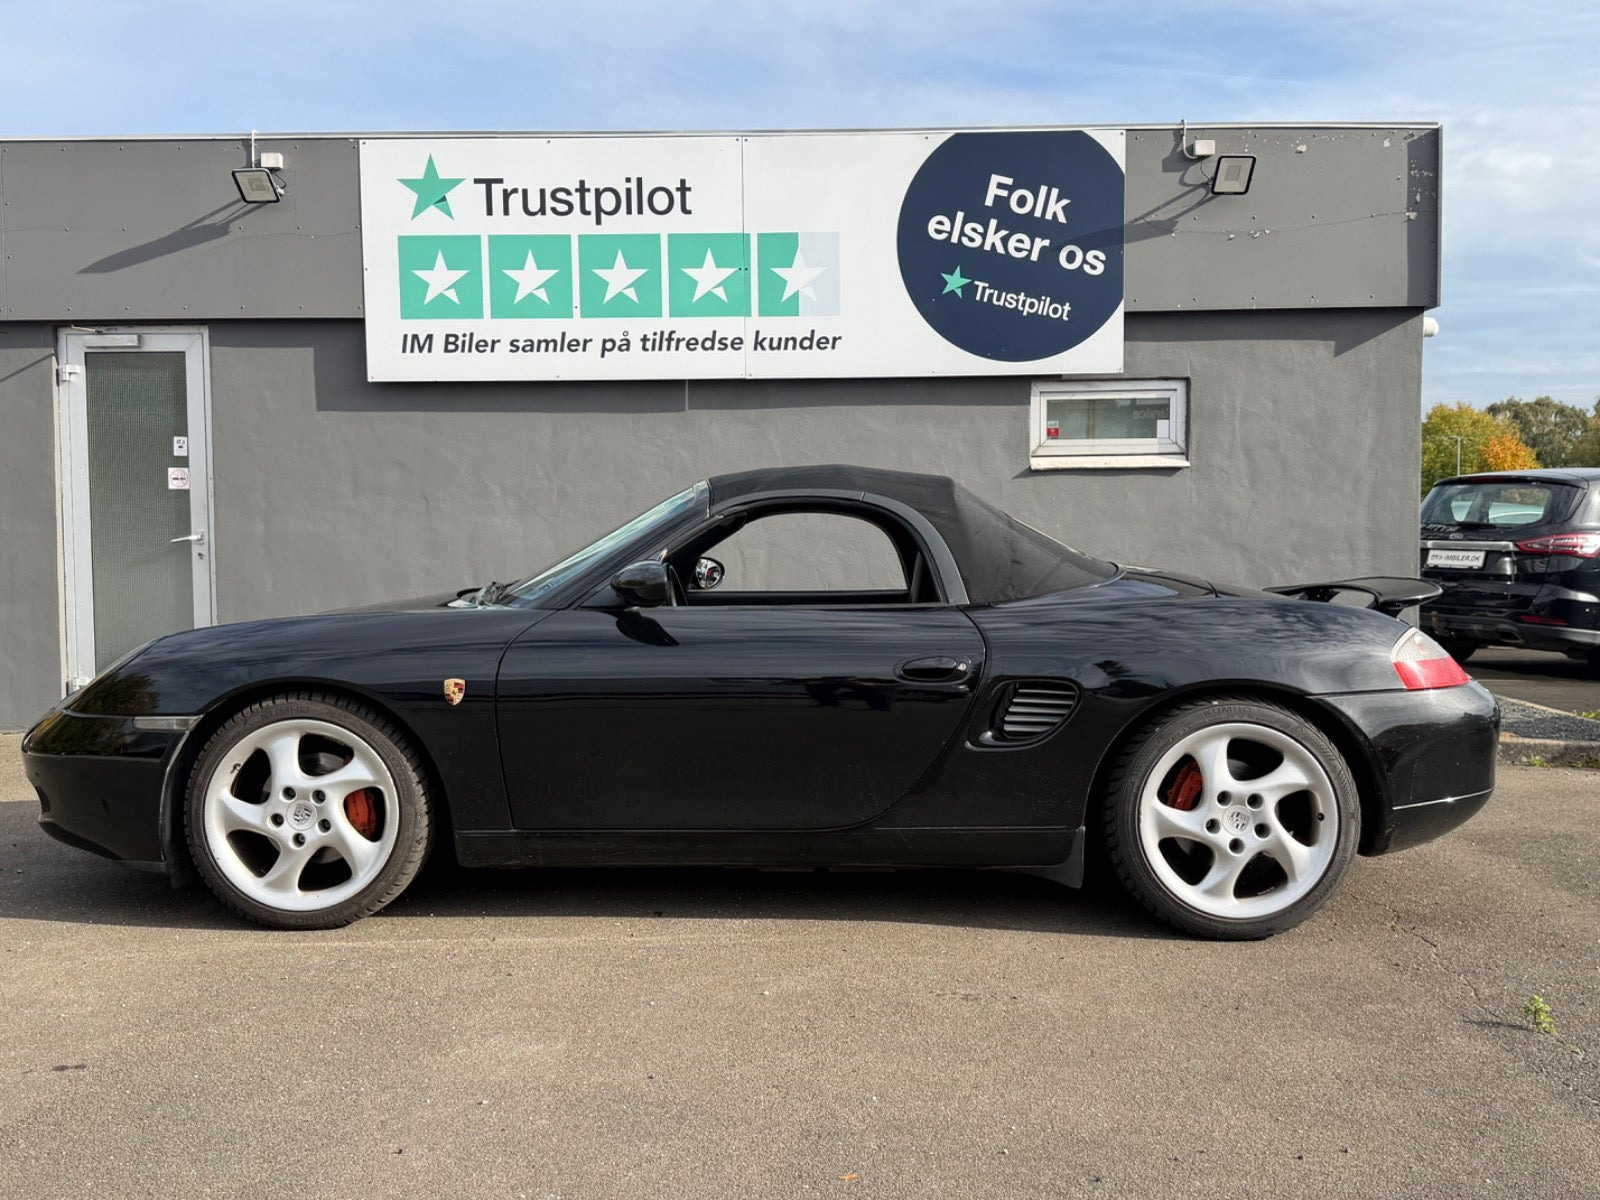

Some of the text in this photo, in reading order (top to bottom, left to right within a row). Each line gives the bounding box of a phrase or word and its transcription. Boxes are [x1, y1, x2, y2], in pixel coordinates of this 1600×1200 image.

[473, 176, 693, 226] Trustpilot
[984, 173, 1071, 224] Folk
[927, 210, 1107, 276] elsker os
[973, 280, 1072, 321] Trustpilot
[401, 329, 842, 358] IM Biler samler på tilfredse kunder
